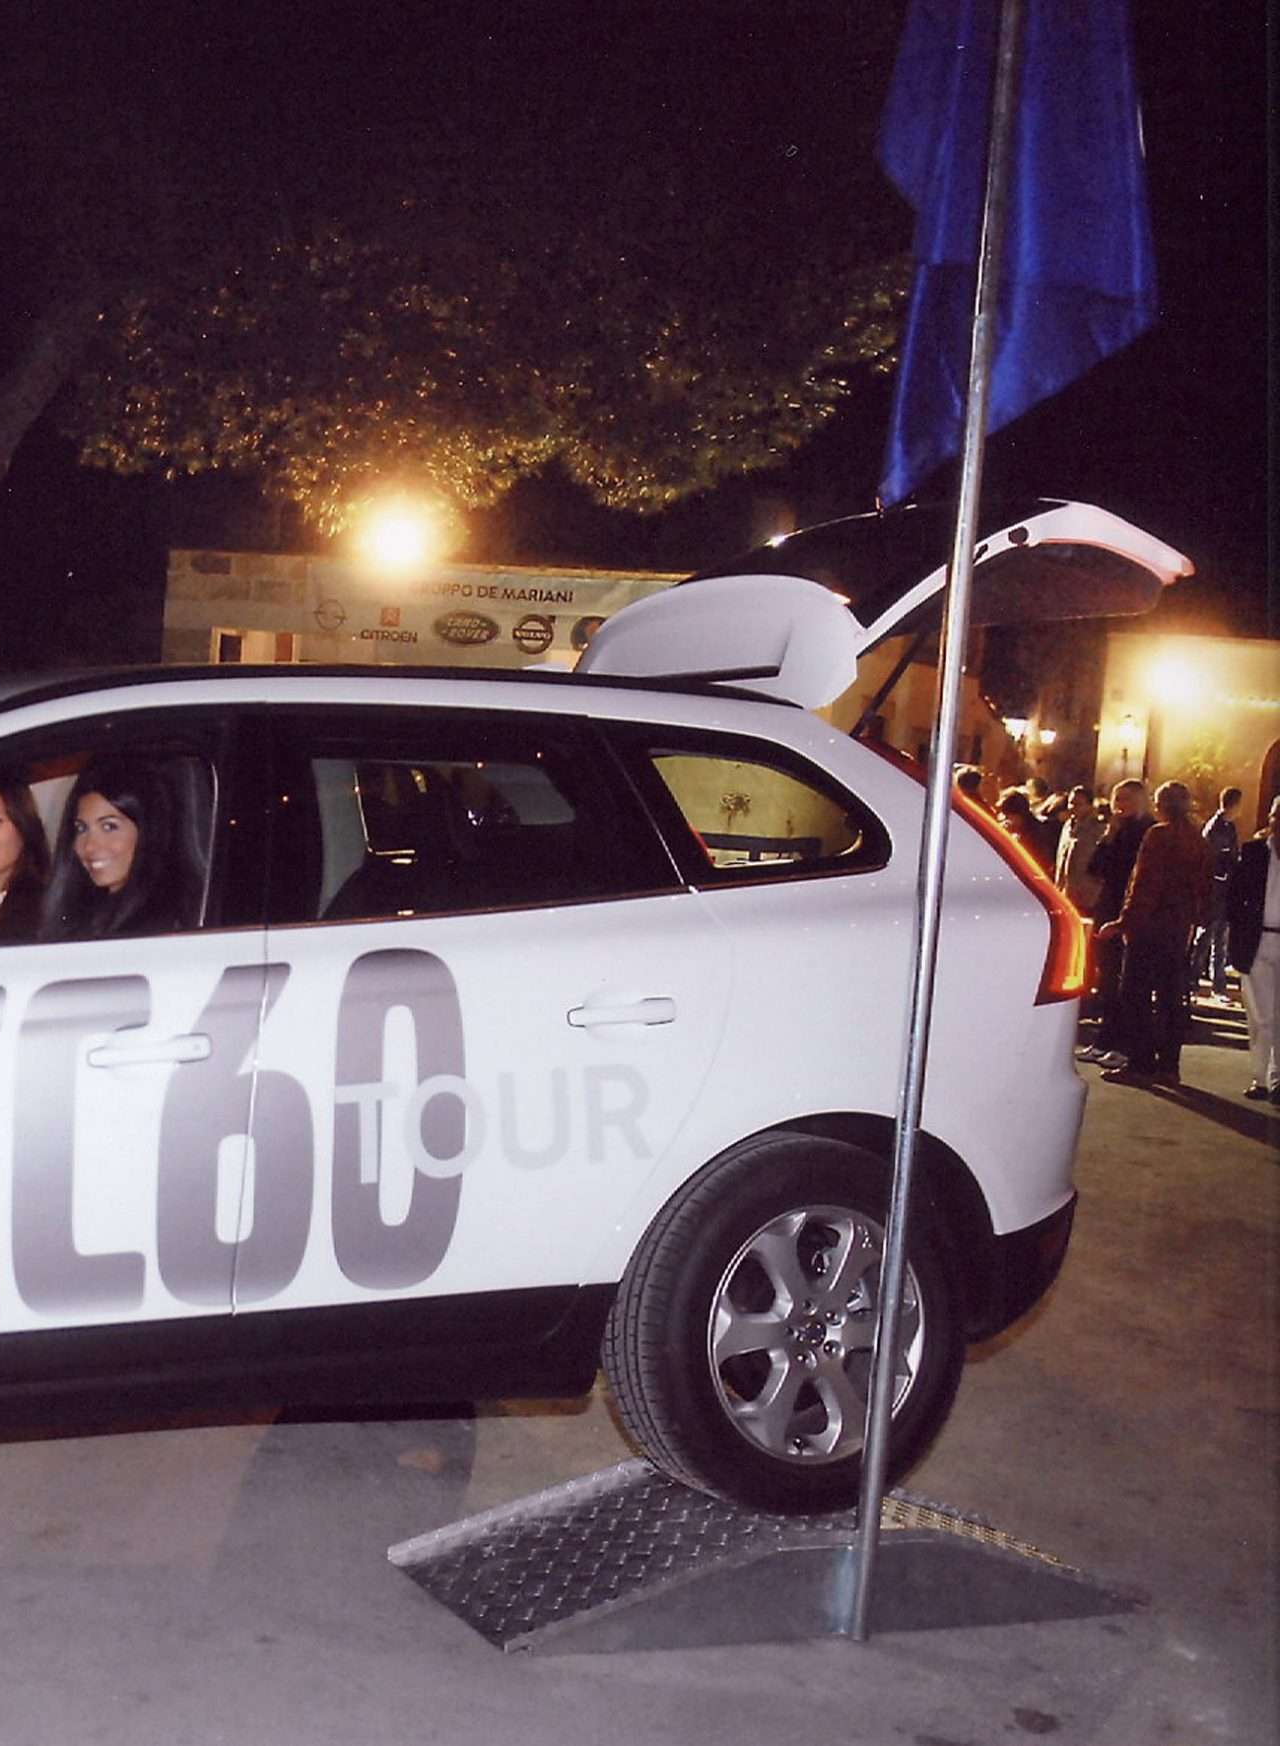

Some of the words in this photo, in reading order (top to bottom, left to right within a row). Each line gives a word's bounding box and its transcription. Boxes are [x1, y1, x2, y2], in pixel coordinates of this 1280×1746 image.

[477, 586, 498, 599] DE
[502, 588, 574, 603] MARIANI
[333, 1063, 654, 1184] TOUR
